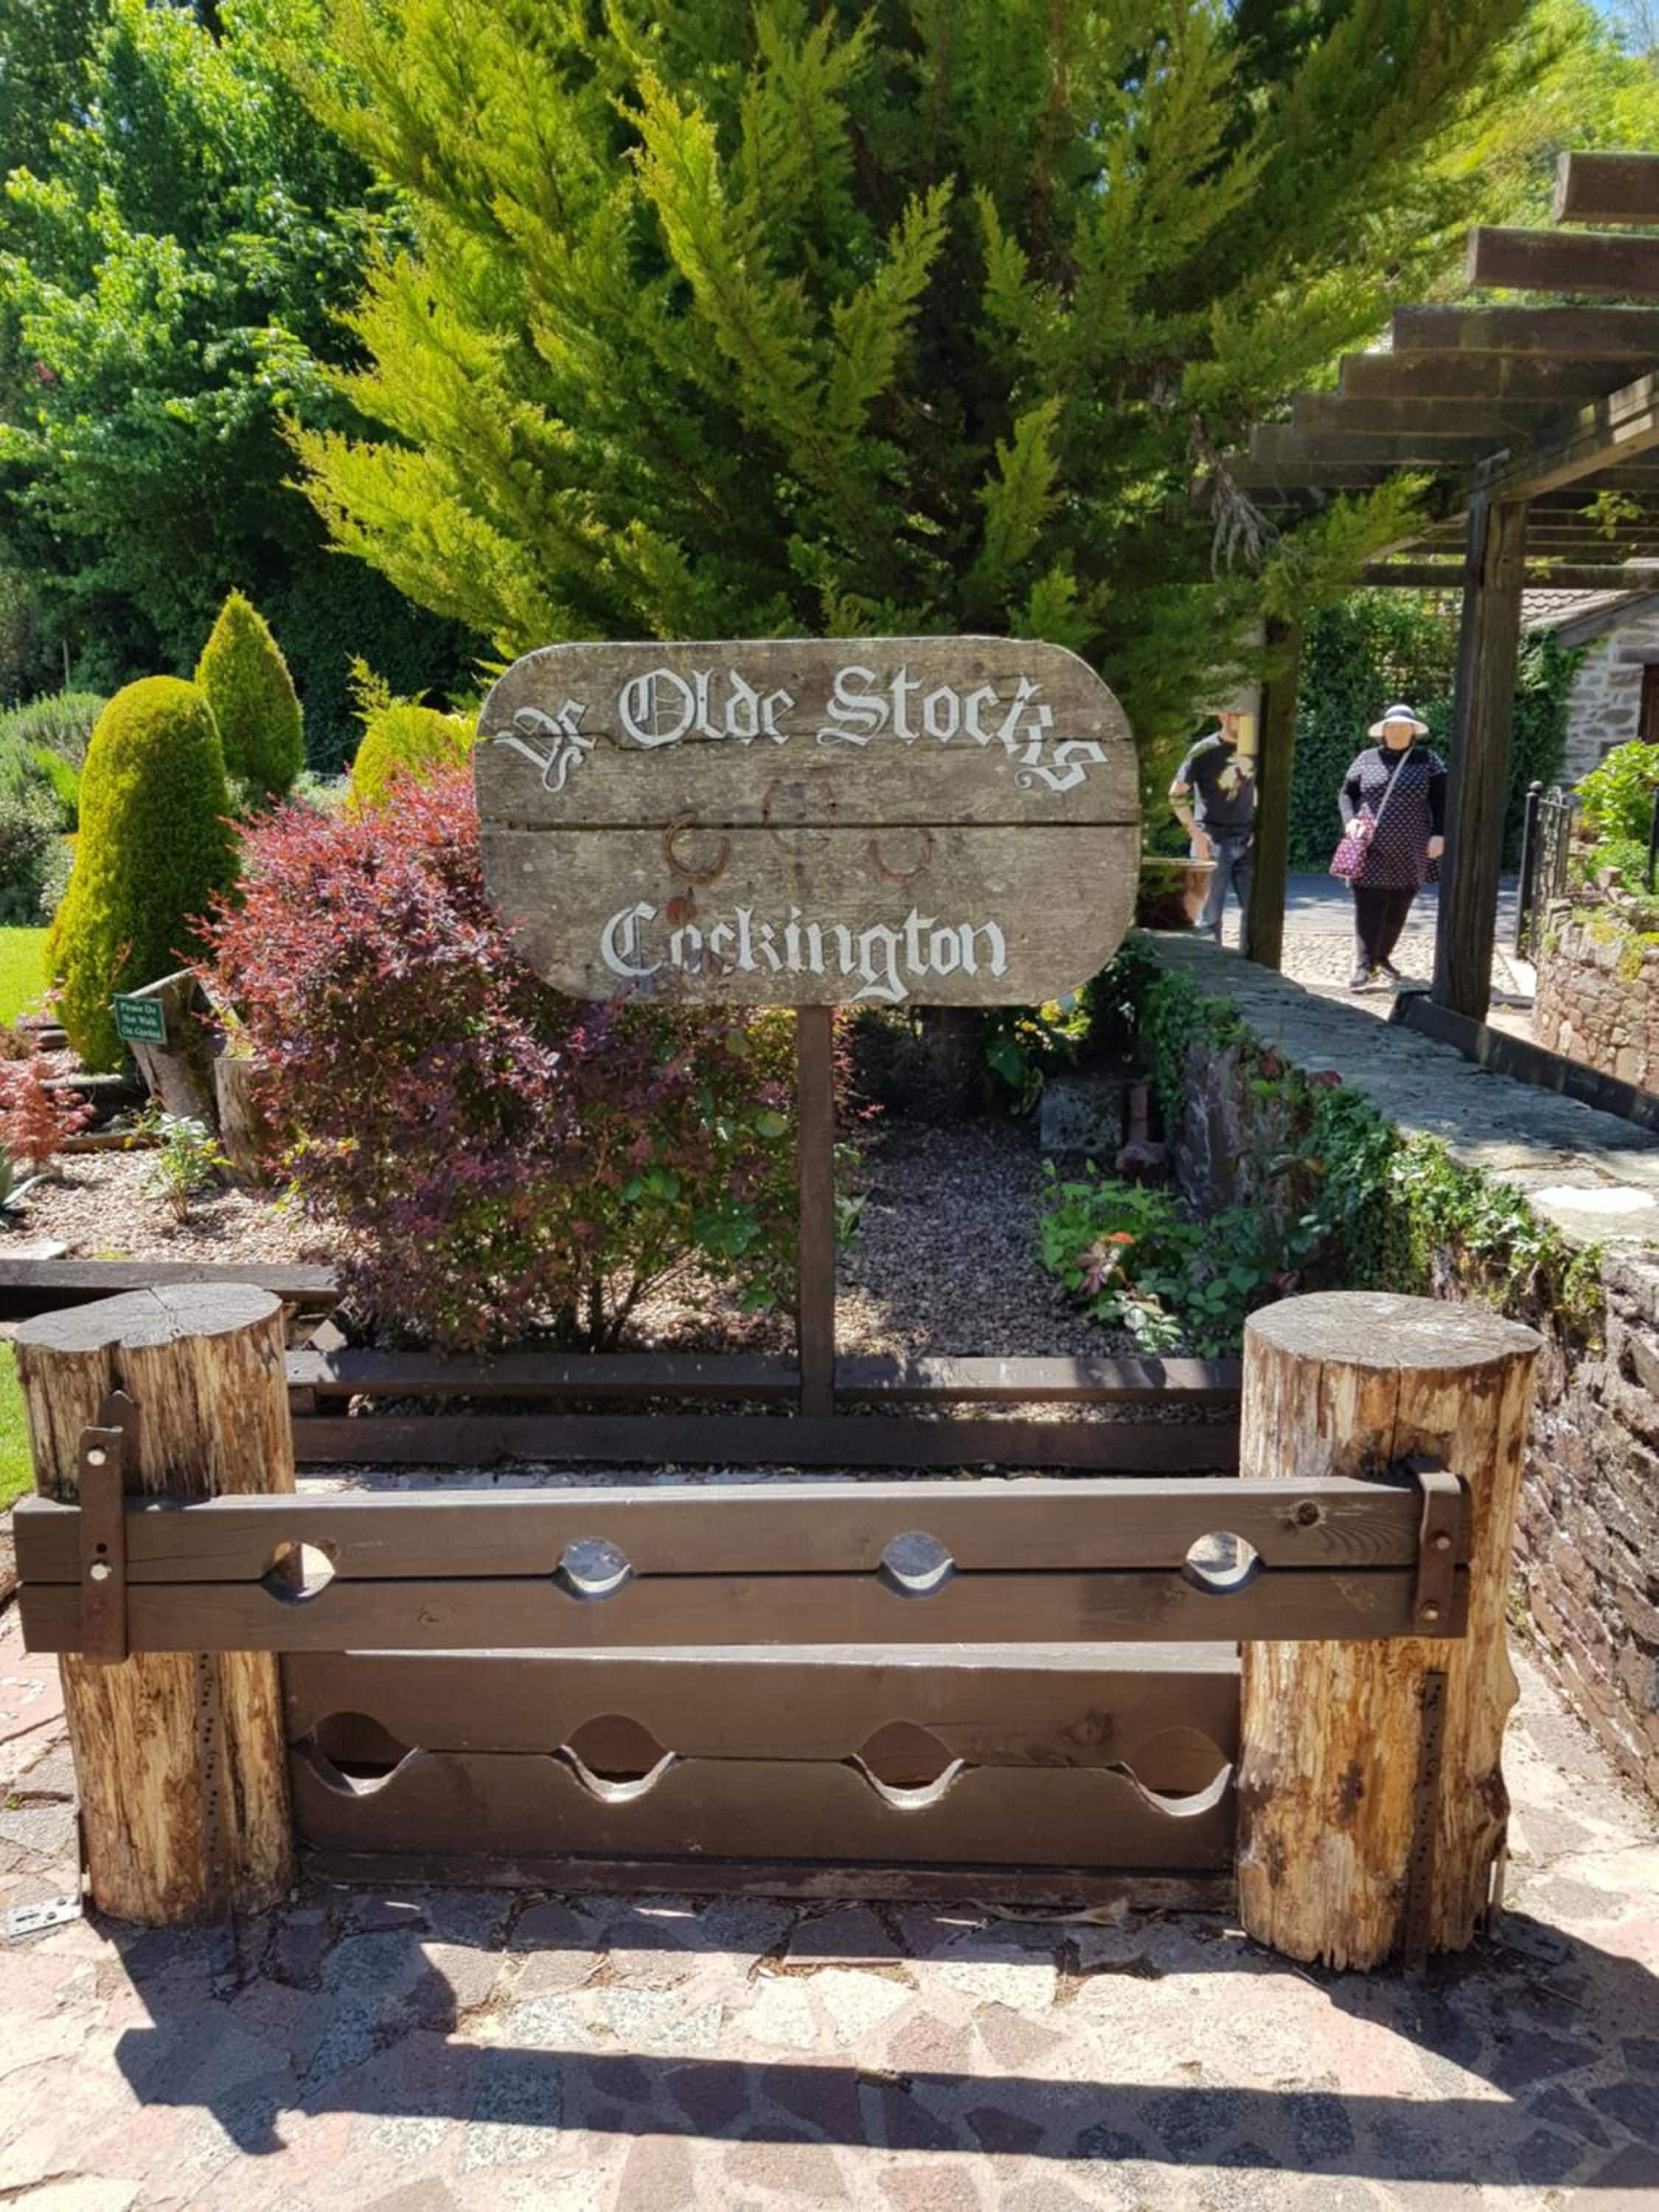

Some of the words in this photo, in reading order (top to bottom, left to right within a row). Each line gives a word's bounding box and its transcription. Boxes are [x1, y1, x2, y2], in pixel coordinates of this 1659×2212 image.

[494, 698, 596, 793] Ye
[618, 667, 799, 748] Olde
[816, 664, 1108, 793] Stocks
[601, 902, 1009, 1004] Cockington
